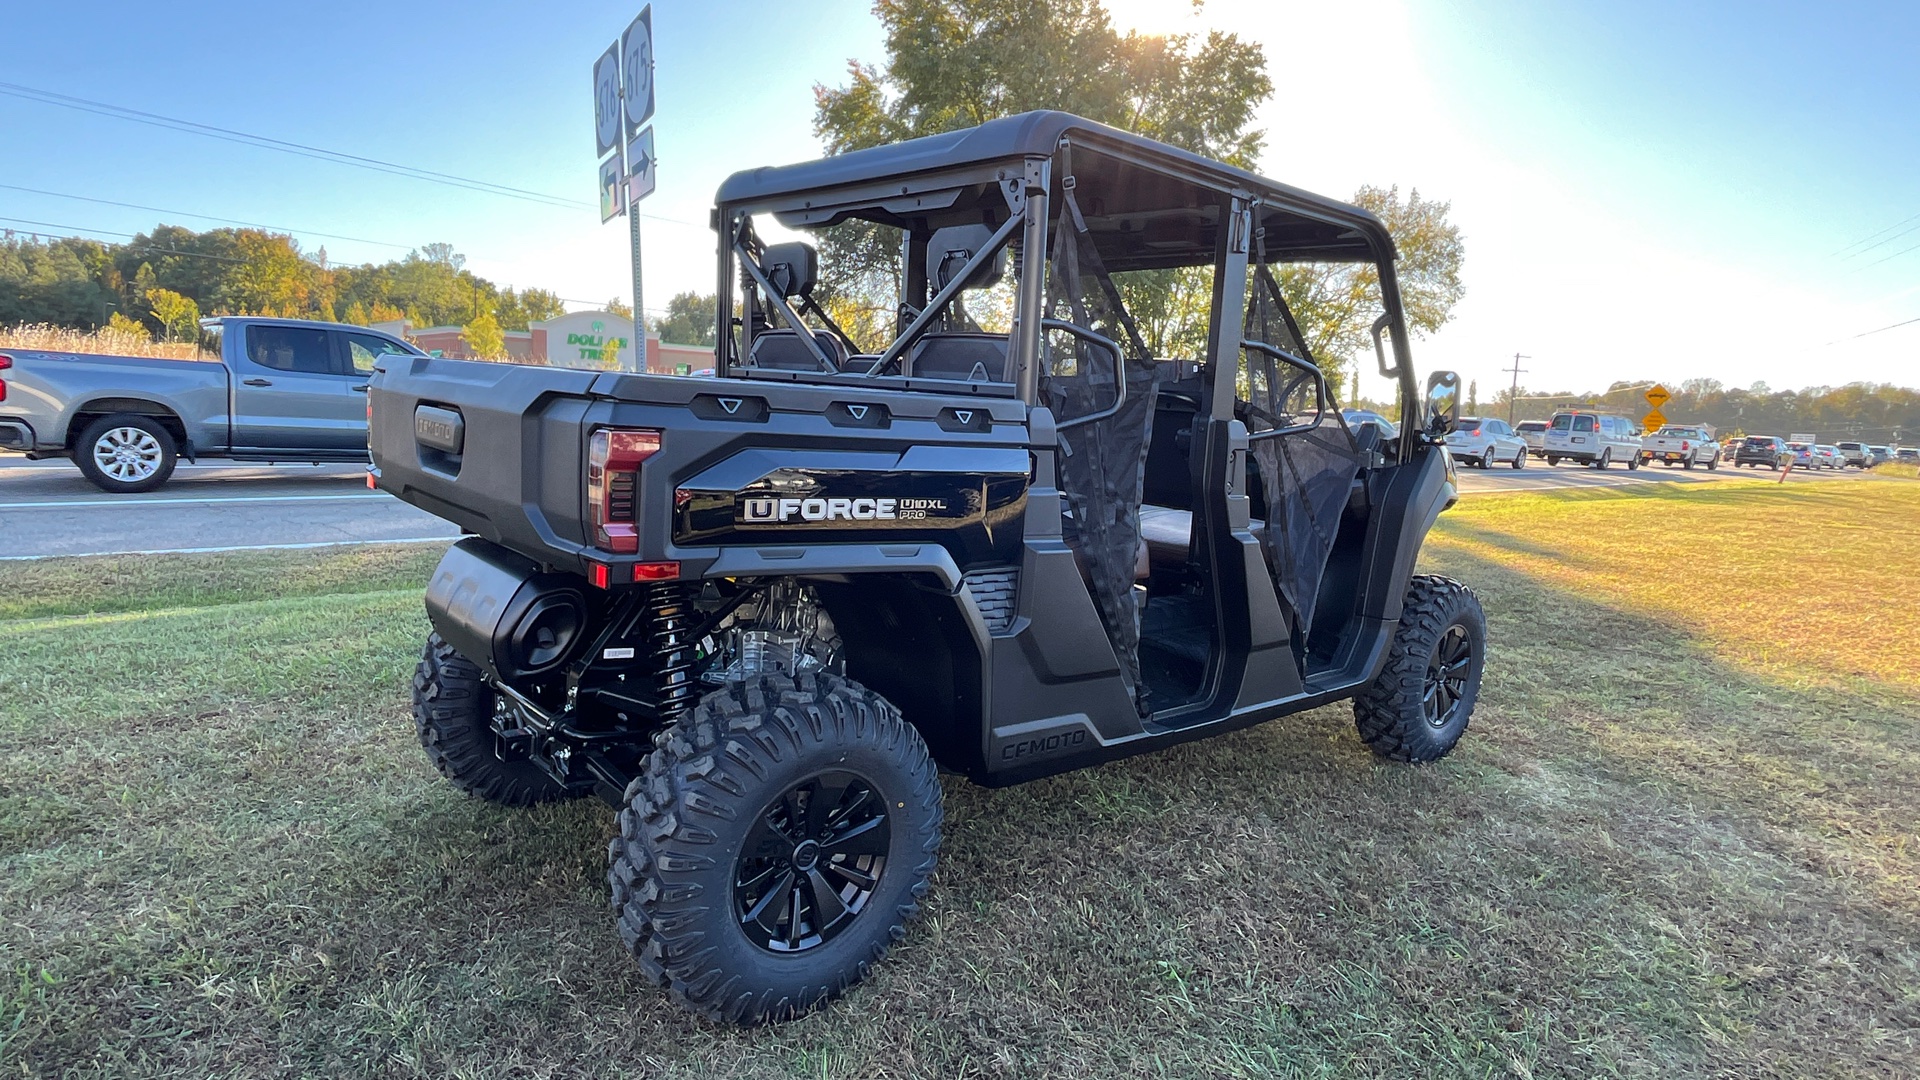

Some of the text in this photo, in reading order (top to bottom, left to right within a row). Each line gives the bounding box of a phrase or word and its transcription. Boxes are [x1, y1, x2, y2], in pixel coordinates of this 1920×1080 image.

[627, 41, 647, 102] 675
[600, 73, 616, 128] 676
[578, 348, 617, 362] TRE
[899, 509, 926, 519] PRO
[1002, 730, 1086, 760] CFMOTO
